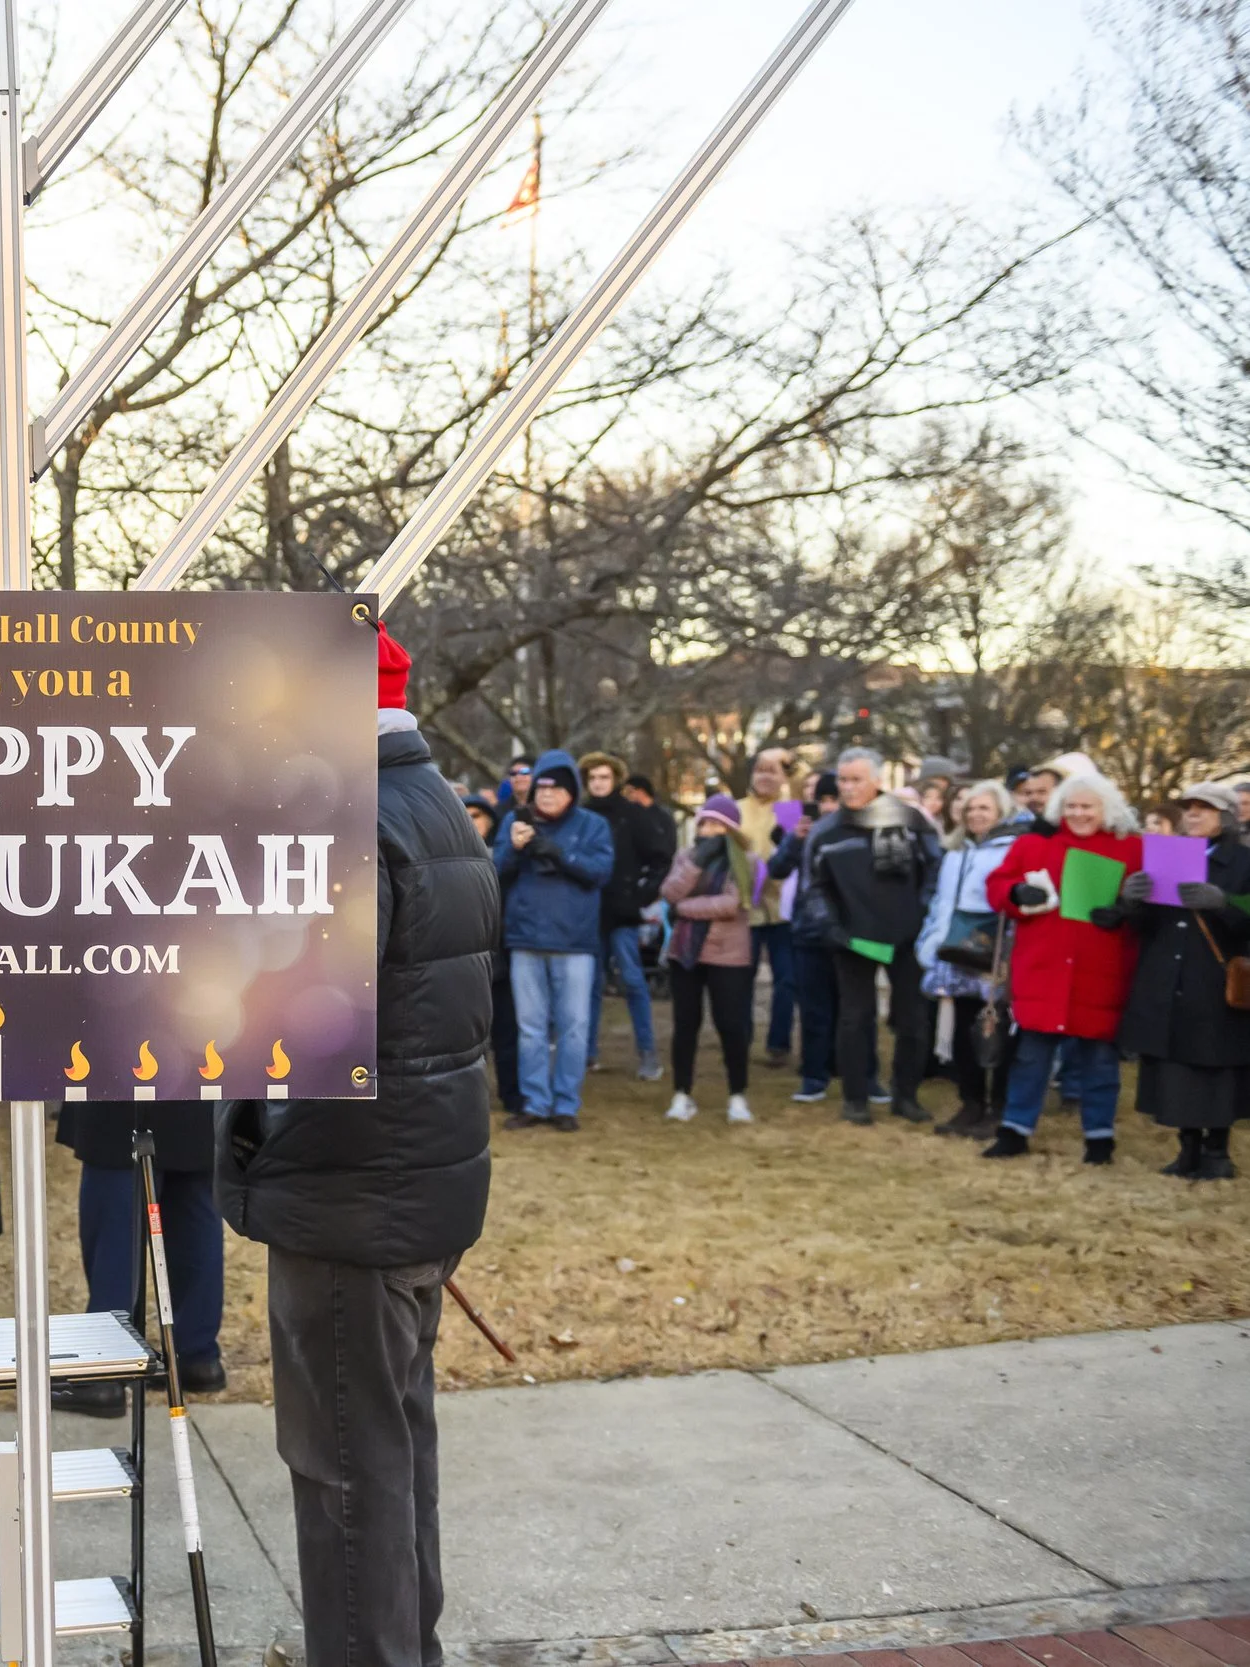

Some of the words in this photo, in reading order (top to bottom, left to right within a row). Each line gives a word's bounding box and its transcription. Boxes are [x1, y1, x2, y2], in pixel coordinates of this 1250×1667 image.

[70, 615, 202, 651] County
[11, 669, 93, 706] you
[106, 669, 131, 697] a
